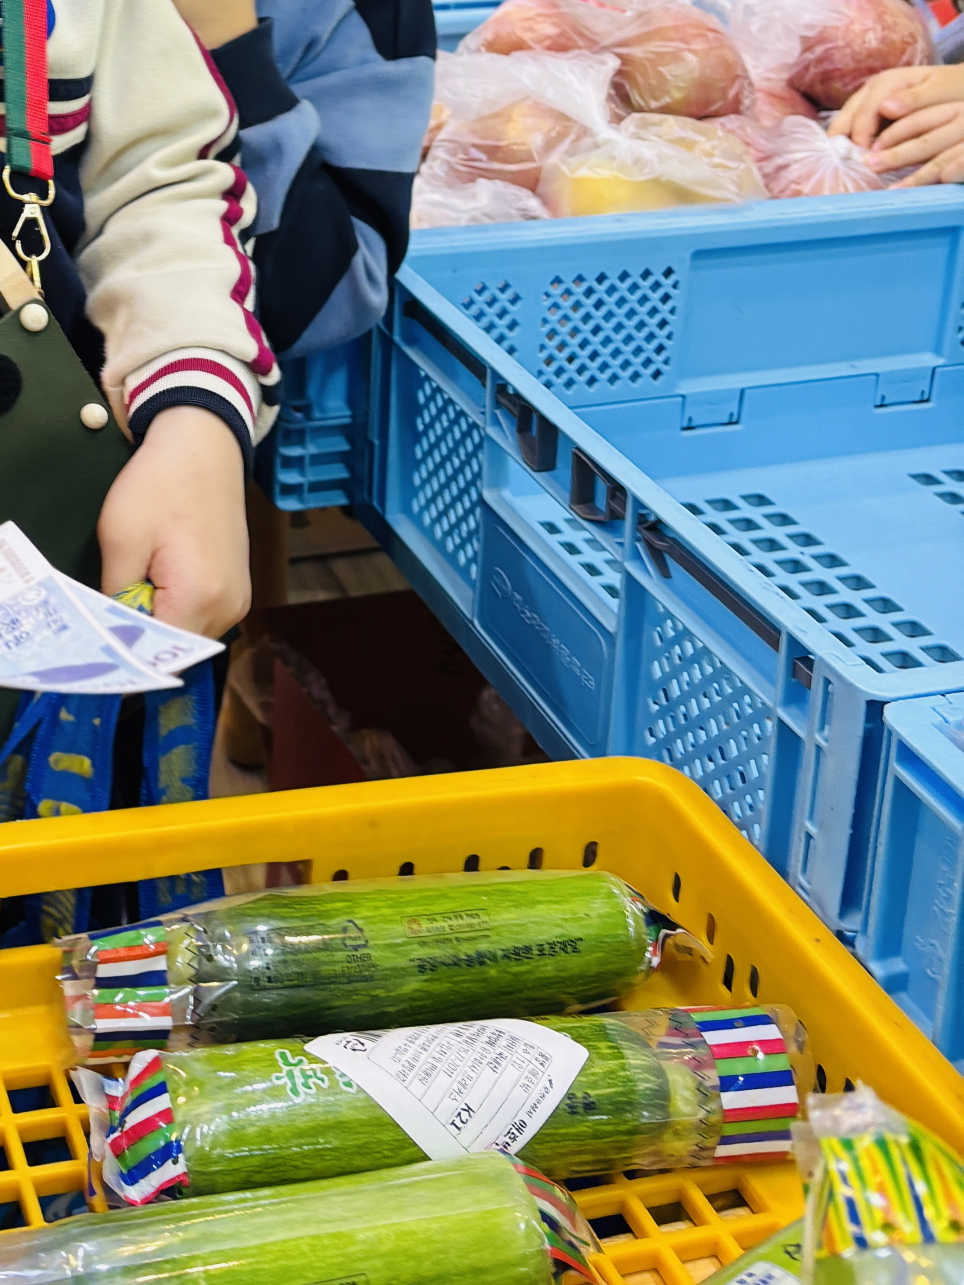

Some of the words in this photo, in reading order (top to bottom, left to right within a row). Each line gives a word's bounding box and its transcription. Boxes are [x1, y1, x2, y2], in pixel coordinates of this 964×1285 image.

[344, 952, 372, 965] OTHER
[442, 1046, 471, 1078] 1577-7011
[485, 1051, 508, 1074] 국내산
[519, 1068, 540, 1094] 애호박
[449, 1102, 476, 1131] K21
